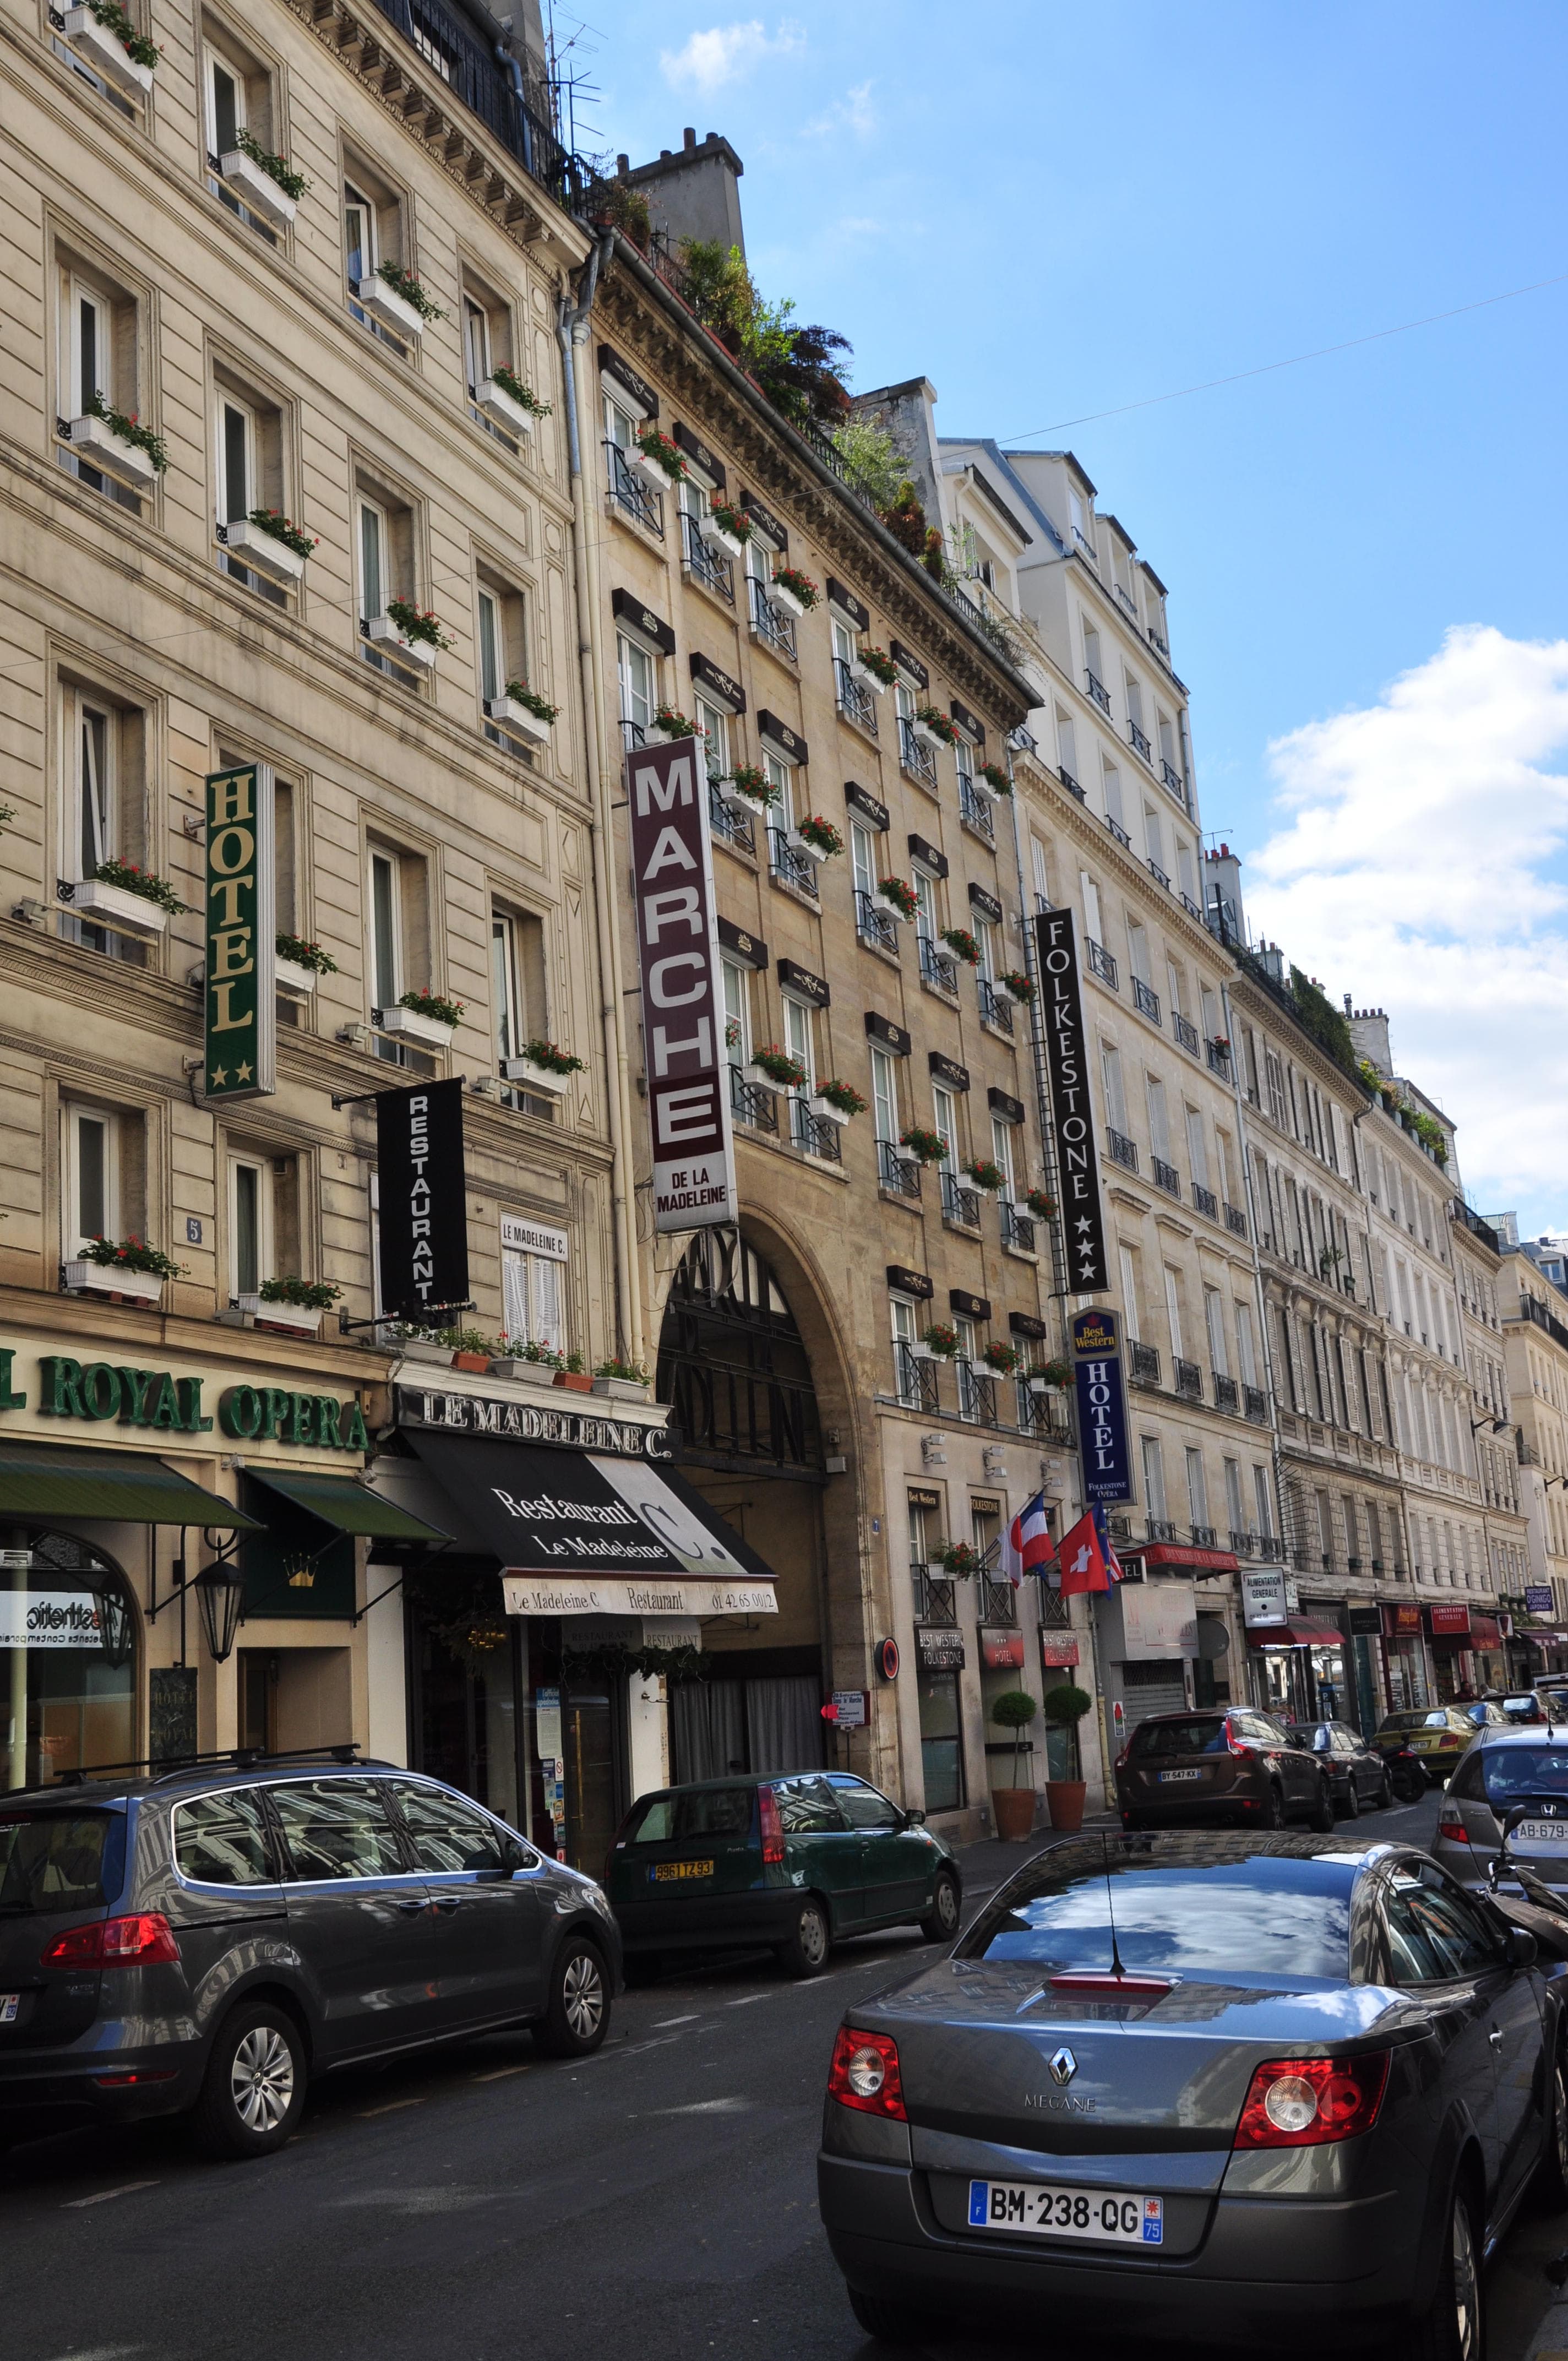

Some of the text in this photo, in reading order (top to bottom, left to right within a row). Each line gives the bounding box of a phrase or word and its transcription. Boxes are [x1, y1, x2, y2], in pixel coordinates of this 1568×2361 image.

[209, 773, 254, 1033] HOTEL
[635, 756, 717, 1144] MARCHE
[1046, 921, 1088, 1200] FOLKESTONE
[672, 1167, 709, 1189] DE LA
[410, 1096, 433, 1300] RESTAURANT
[657, 1185, 726, 1212] MADELEINE
[190, 1221, 198, 1240] 5
[503, 1223, 565, 1254] LE MADELEINE C.
[1083, 1326, 1105, 1339] Best
[1075, 1335, 1115, 1348] Western
[37, 1355, 213, 1433] ROYAL
[219, 1384, 369, 1451] OPERA
[420, 1391, 468, 1428] LE
[471, 1399, 643, 1454] MADELEINE
[1087, 1362, 1114, 1470] HOTEL
[1088, 1481, 1127, 1491] FOLKESTONE
[909, 1490, 936, 1504] Best Western
[971, 1498, 999, 1512] FOLKESTONE
[491, 1488, 638, 1525] Restaurant
[531, 1535, 569, 1556] Le
[564, 1536, 668, 1558] Madeleine
[1247, 1576, 1281, 1587] ALIMENTATION
[512, 1587, 774, 1610] Le Madeleine C Restaurant 01 42 65 0012
[1252, 1588, 1278, 1599] GENERALE
[571, 1629, 634, 1642] RESTAURANT
[647, 1634, 699, 1647] RESTAURANT
[920, 1634, 963, 1647] BEST WESTERN
[924, 1651, 962, 1664] FOLKESTONE
[995, 1650, 1013, 1662] HOTEL
[1047, 1649, 1076, 1661] FOLKESTONE
[657, 1862, 710, 1878] 9961 TZ 93
[7, 2007, 15, 2016] 92
[1024, 2094, 1096, 2112] MEGANE
[976, 2207, 981, 2216] F
[990, 2188, 1138, 2233] BM-238-QG
[1146, 2223, 1159, 2238] 75
